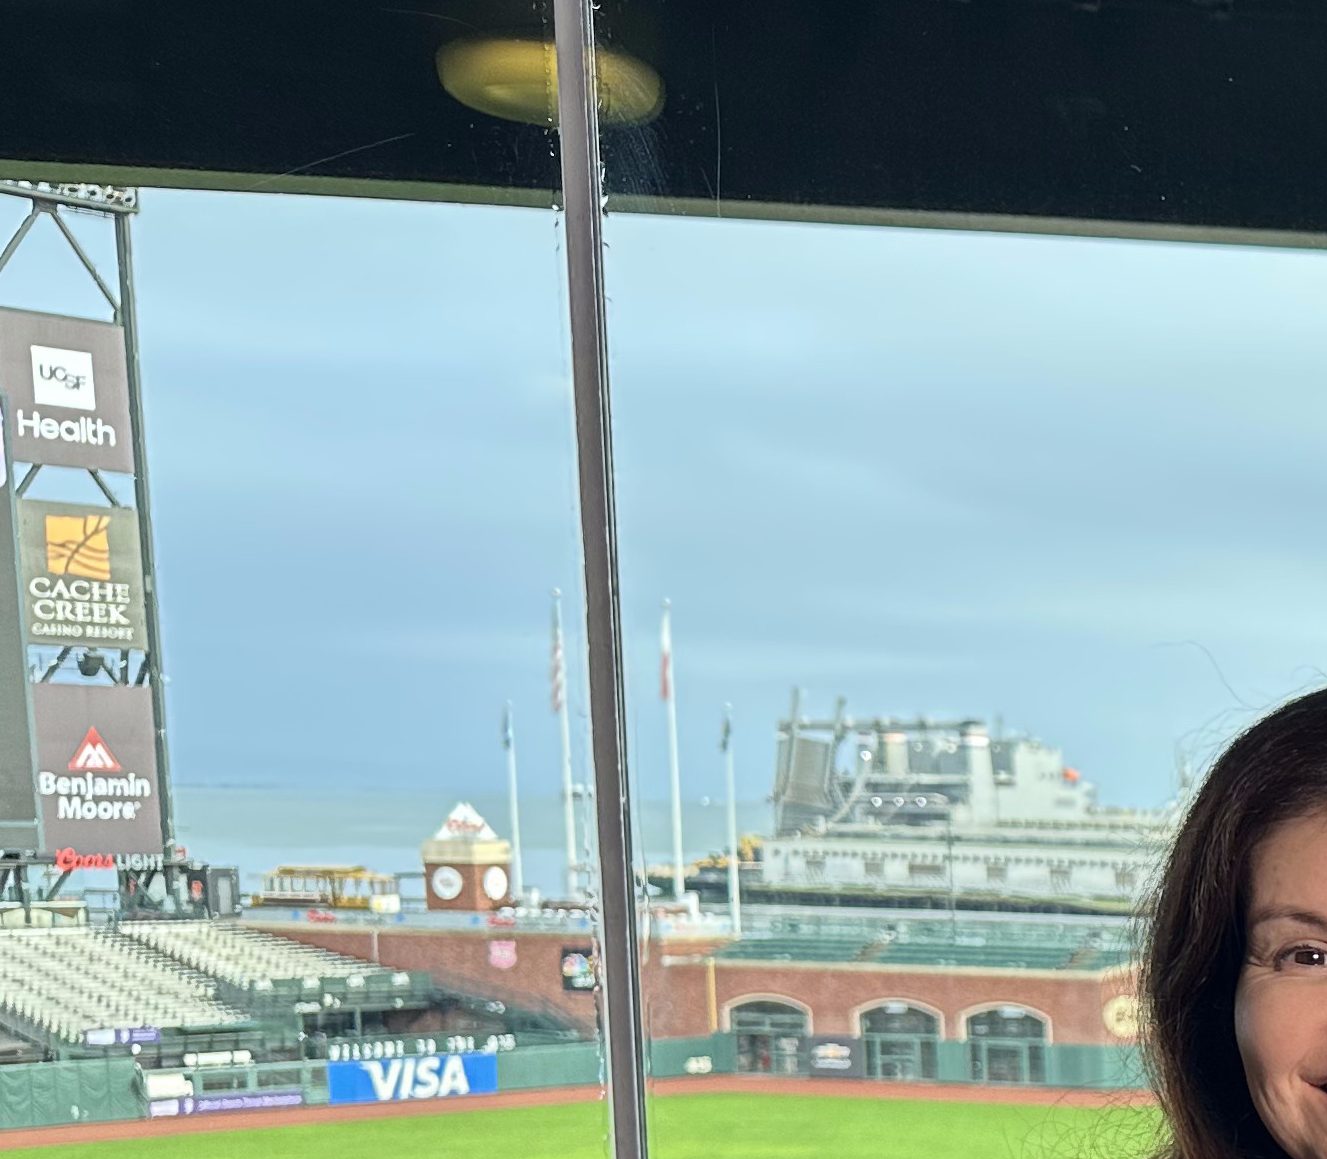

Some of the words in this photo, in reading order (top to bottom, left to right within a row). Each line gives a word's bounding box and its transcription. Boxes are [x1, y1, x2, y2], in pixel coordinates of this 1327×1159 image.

[39, 364, 87, 391] UCSF
[17, 408, 117, 447] Health
[29, 576, 131, 604] CACHE
[33, 599, 131, 625] CREEK
[39, 772, 151, 800] Benjamin
[55, 847, 115, 871] Coors
[116, 853, 165, 871] LIGHT
[359, 1054, 471, 1101] VISA
